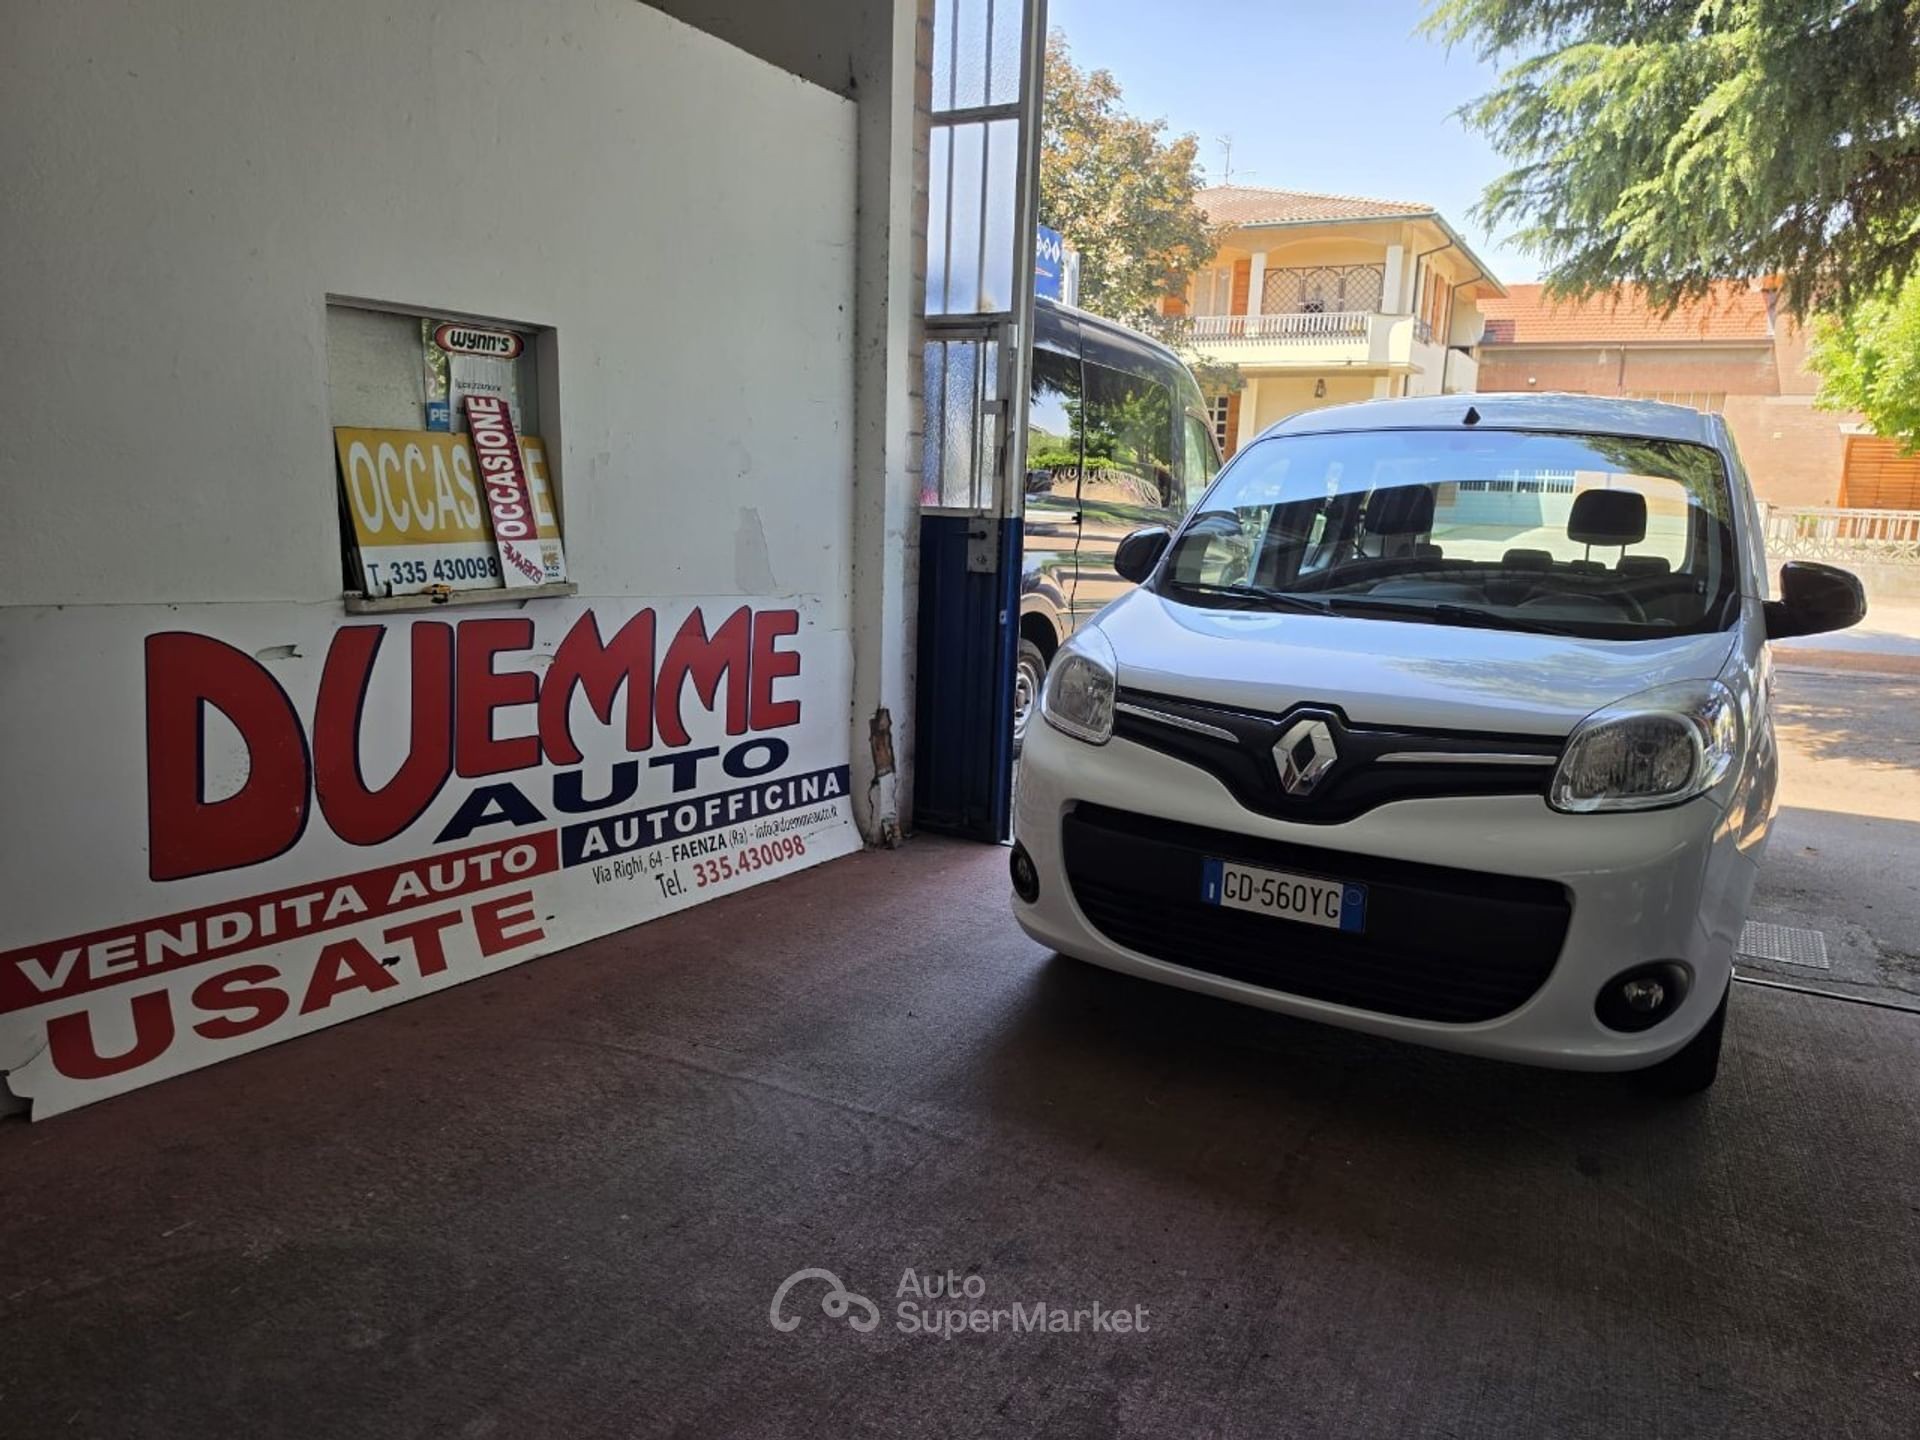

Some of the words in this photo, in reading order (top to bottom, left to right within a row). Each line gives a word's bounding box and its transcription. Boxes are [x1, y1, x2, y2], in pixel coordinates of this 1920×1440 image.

[349, 441, 554, 533] OCCASE
[467, 397, 528, 538] OCCASIONE
[390, 561, 427, 585] 335
[433, 556, 498, 581] 430098
[145, 605, 801, 882] DUEMME
[433, 737, 790, 844] AUTO
[581, 772, 841, 858] AUTOFFICINA
[592, 865, 612, 885] Via
[615, 856, 648, 880] Righi,
[650, 851, 663, 870] 64
[672, 834, 728, 863] FAENZA
[729, 829, 749, 850] (Ra)
[655, 869, 688, 899] Tel.
[693, 835, 806, 888] 335.430098
[15, 885, 368, 992] VENDITA
[387, 844, 537, 905] AUTO
[46, 890, 545, 1080] USATE
